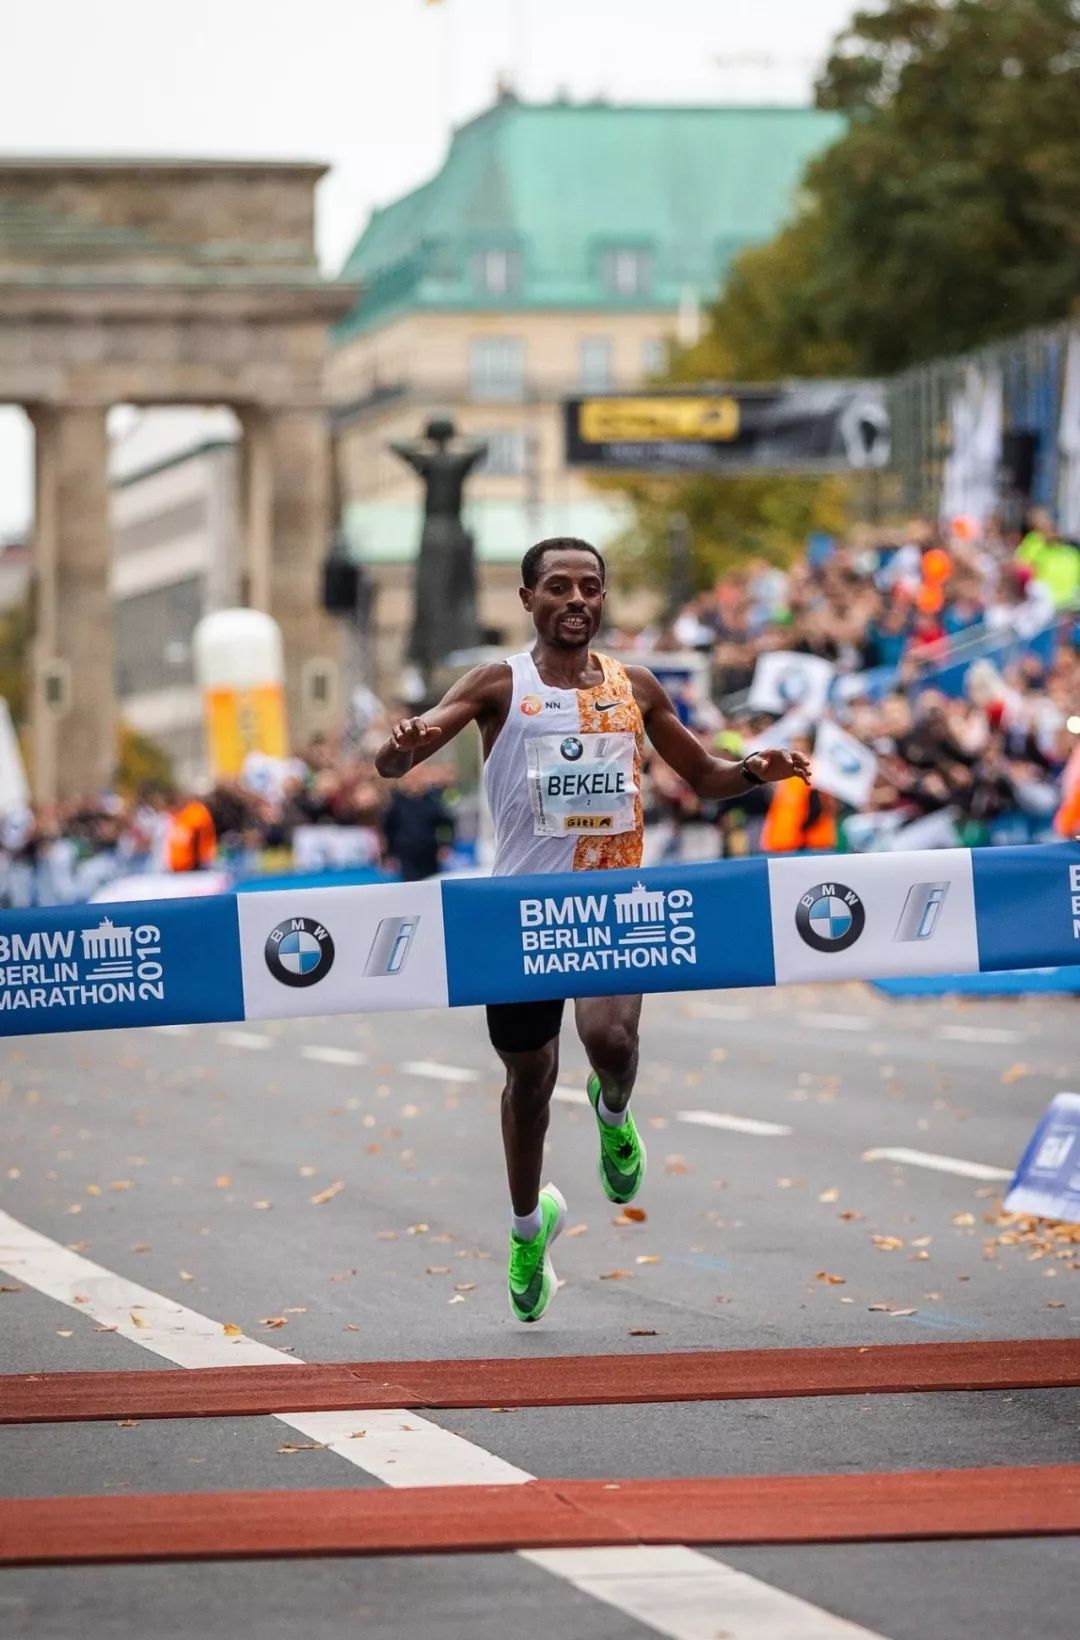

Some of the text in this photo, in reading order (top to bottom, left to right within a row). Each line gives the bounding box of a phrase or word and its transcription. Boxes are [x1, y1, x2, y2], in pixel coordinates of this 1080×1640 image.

[547, 772, 626, 796] BEKELE
[801, 884, 859, 908] BMW
[520, 895, 608, 927] BMW
[270, 918, 329, 942] BMW
[522, 926, 611, 951] BERLIN
[667, 889, 697, 965] 2019
[134, 925, 165, 1000] 2019
[523, 947, 668, 975] MARATHON
[0, 962, 78, 986] ERLIN
